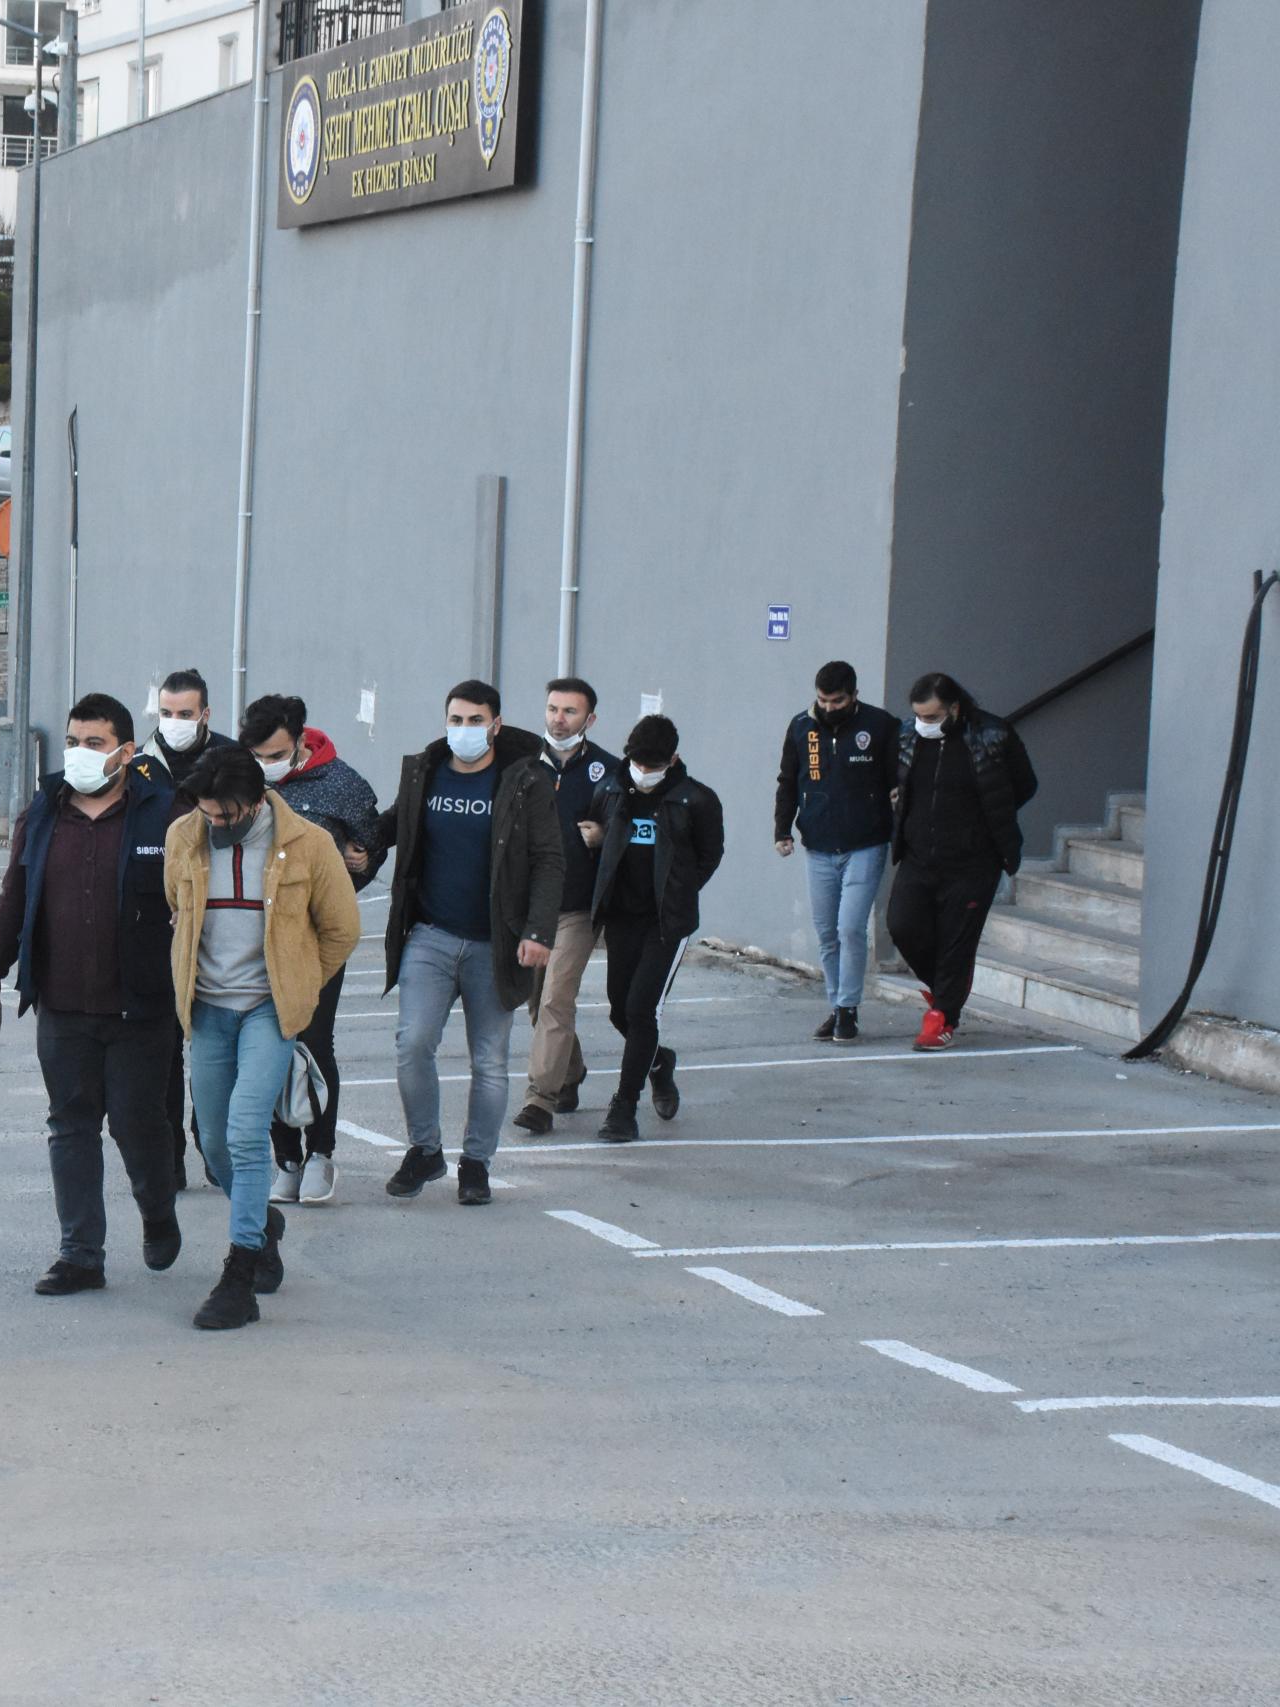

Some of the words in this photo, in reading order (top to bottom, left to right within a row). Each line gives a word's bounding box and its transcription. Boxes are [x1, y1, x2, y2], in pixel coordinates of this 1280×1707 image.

[326, 60, 356, 101] MUĞLA
[358, 56, 367, 92] İL
[369, 46, 409, 88] EMNİYET
[411, 20, 474, 76] MÜDÜRLÜĞÜ
[323, 101, 352, 175] ŞEHİT
[353, 99, 396, 156] MEHMET
[397, 88, 433, 145] KEMAL
[435, 79, 470, 146] COŞAR
[352, 169, 365, 198] EK
[365, 160, 400, 195] HİZMET
[402, 151, 436, 188] BİNASI
[427, 795, 493, 815] MISSIO
